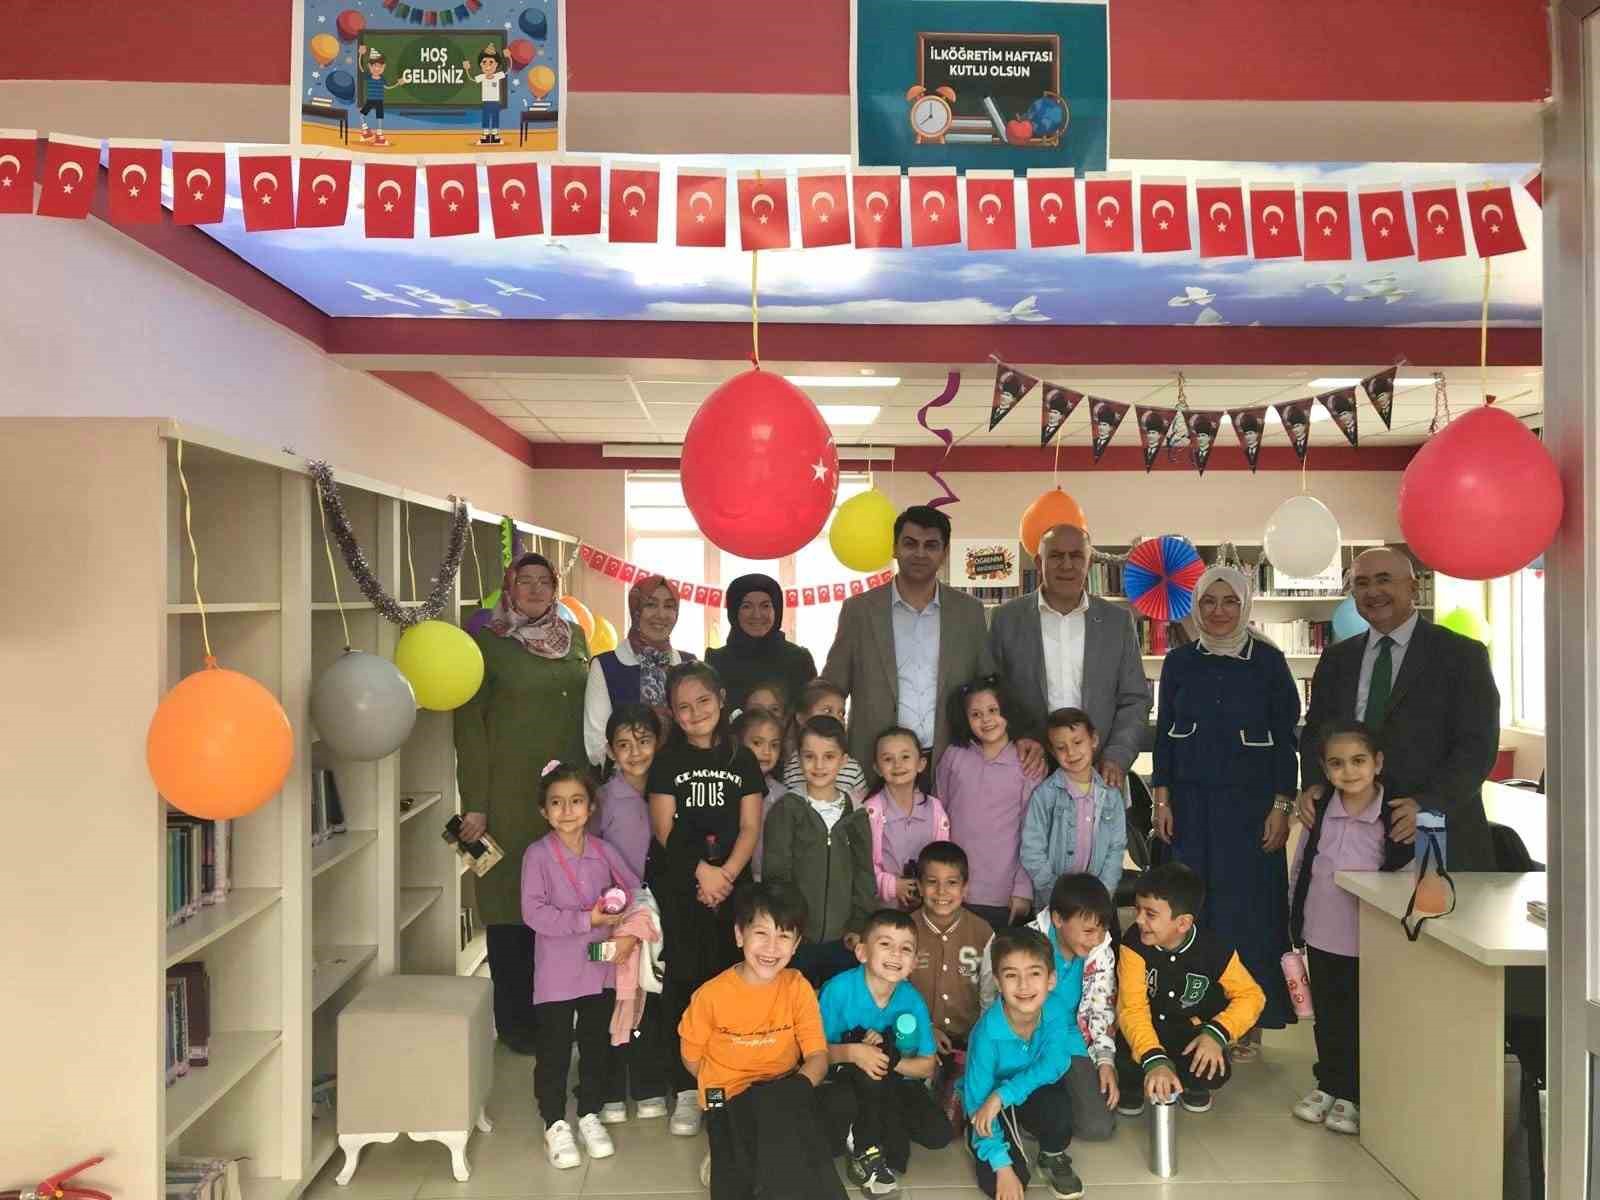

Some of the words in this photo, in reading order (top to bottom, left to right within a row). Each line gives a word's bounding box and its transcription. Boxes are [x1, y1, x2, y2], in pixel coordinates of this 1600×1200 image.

[420, 47, 448, 67] HOŞ
[930, 46, 1003, 62] İLKÖĞRETİM
[1004, 50, 1053, 62] HAFTASI
[402, 66, 463, 84] GELDİNİZ
[949, 65, 988, 77] KUTLU
[989, 66, 1031, 77] OLSUN
[674, 771, 692, 786] CE
[1180, 972, 1209, 1008] B
